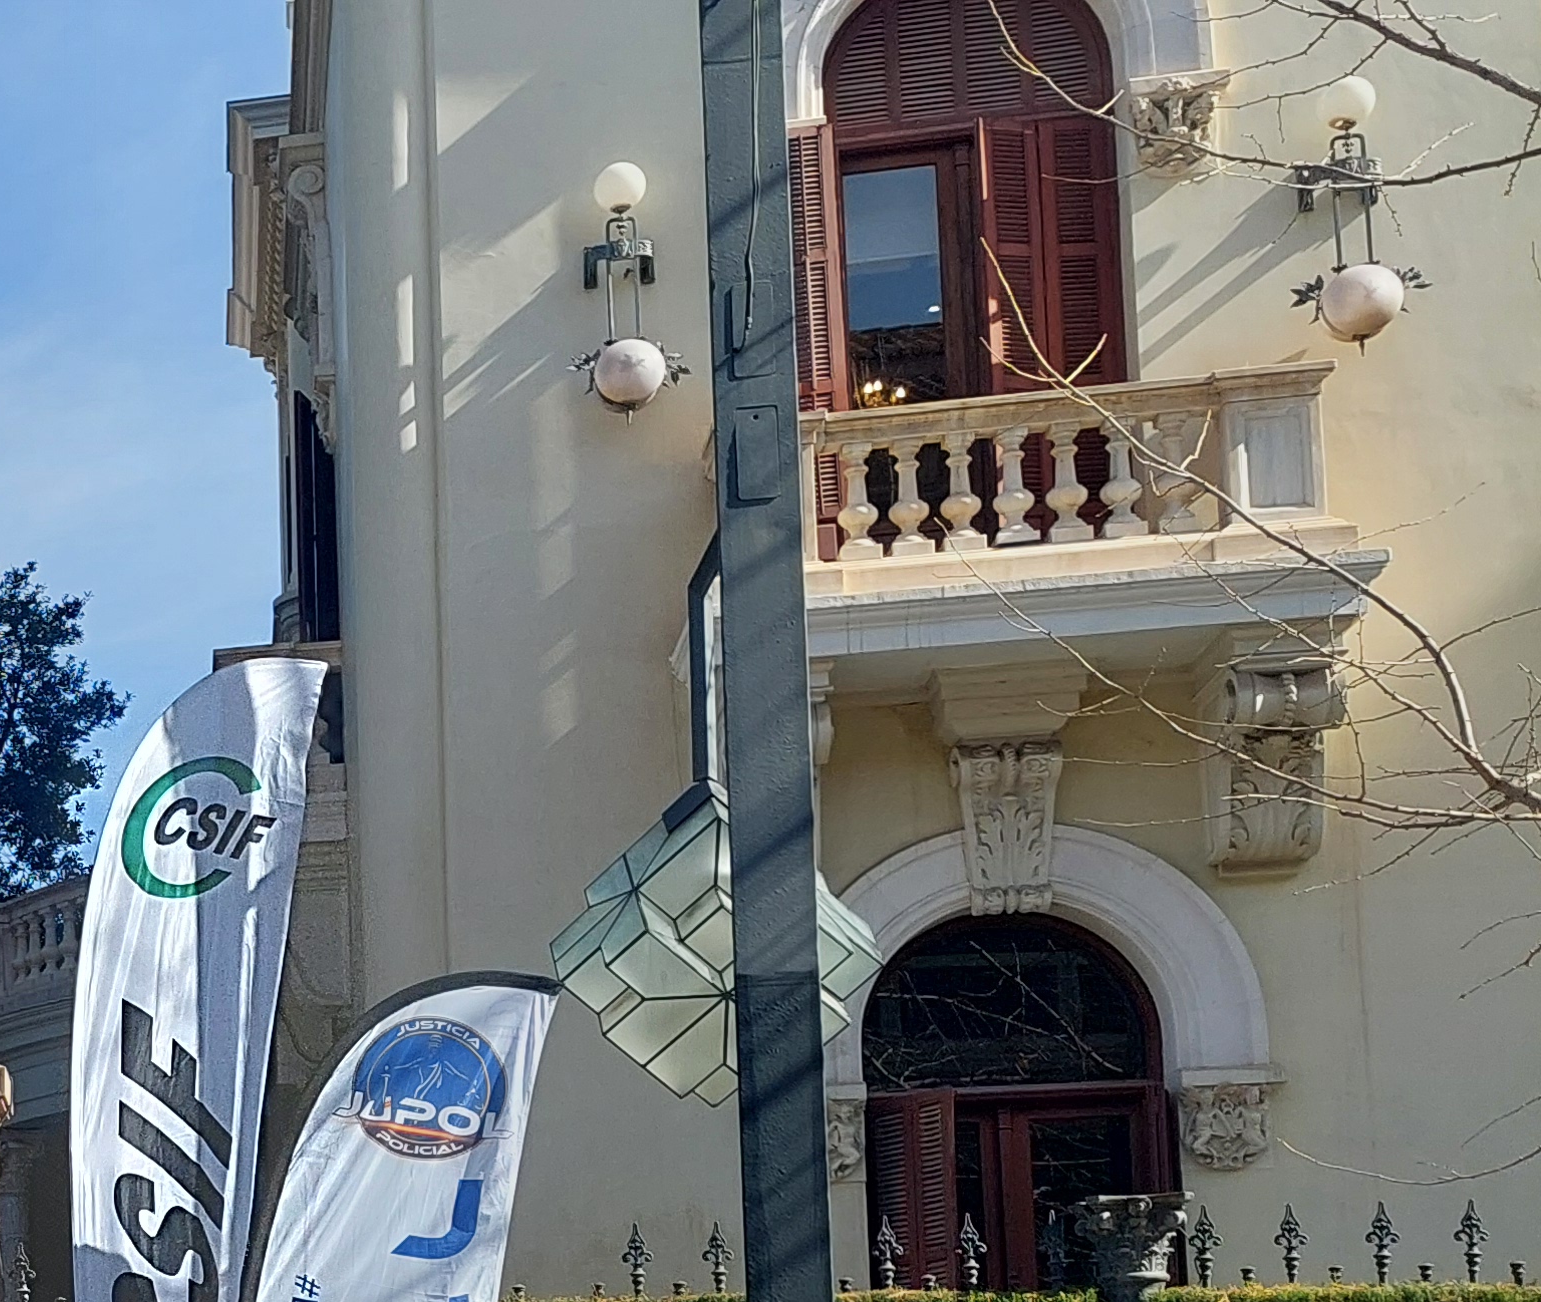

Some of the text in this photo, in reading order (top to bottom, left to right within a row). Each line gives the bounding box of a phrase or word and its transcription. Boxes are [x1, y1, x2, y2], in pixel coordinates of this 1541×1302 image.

[154, 797, 276, 860] CSIF
[397, 1020, 480, 1050] JUSTICIA
[332, 1091, 514, 1139] JUPOL
[376, 1130, 464, 1156] POLICIAL
